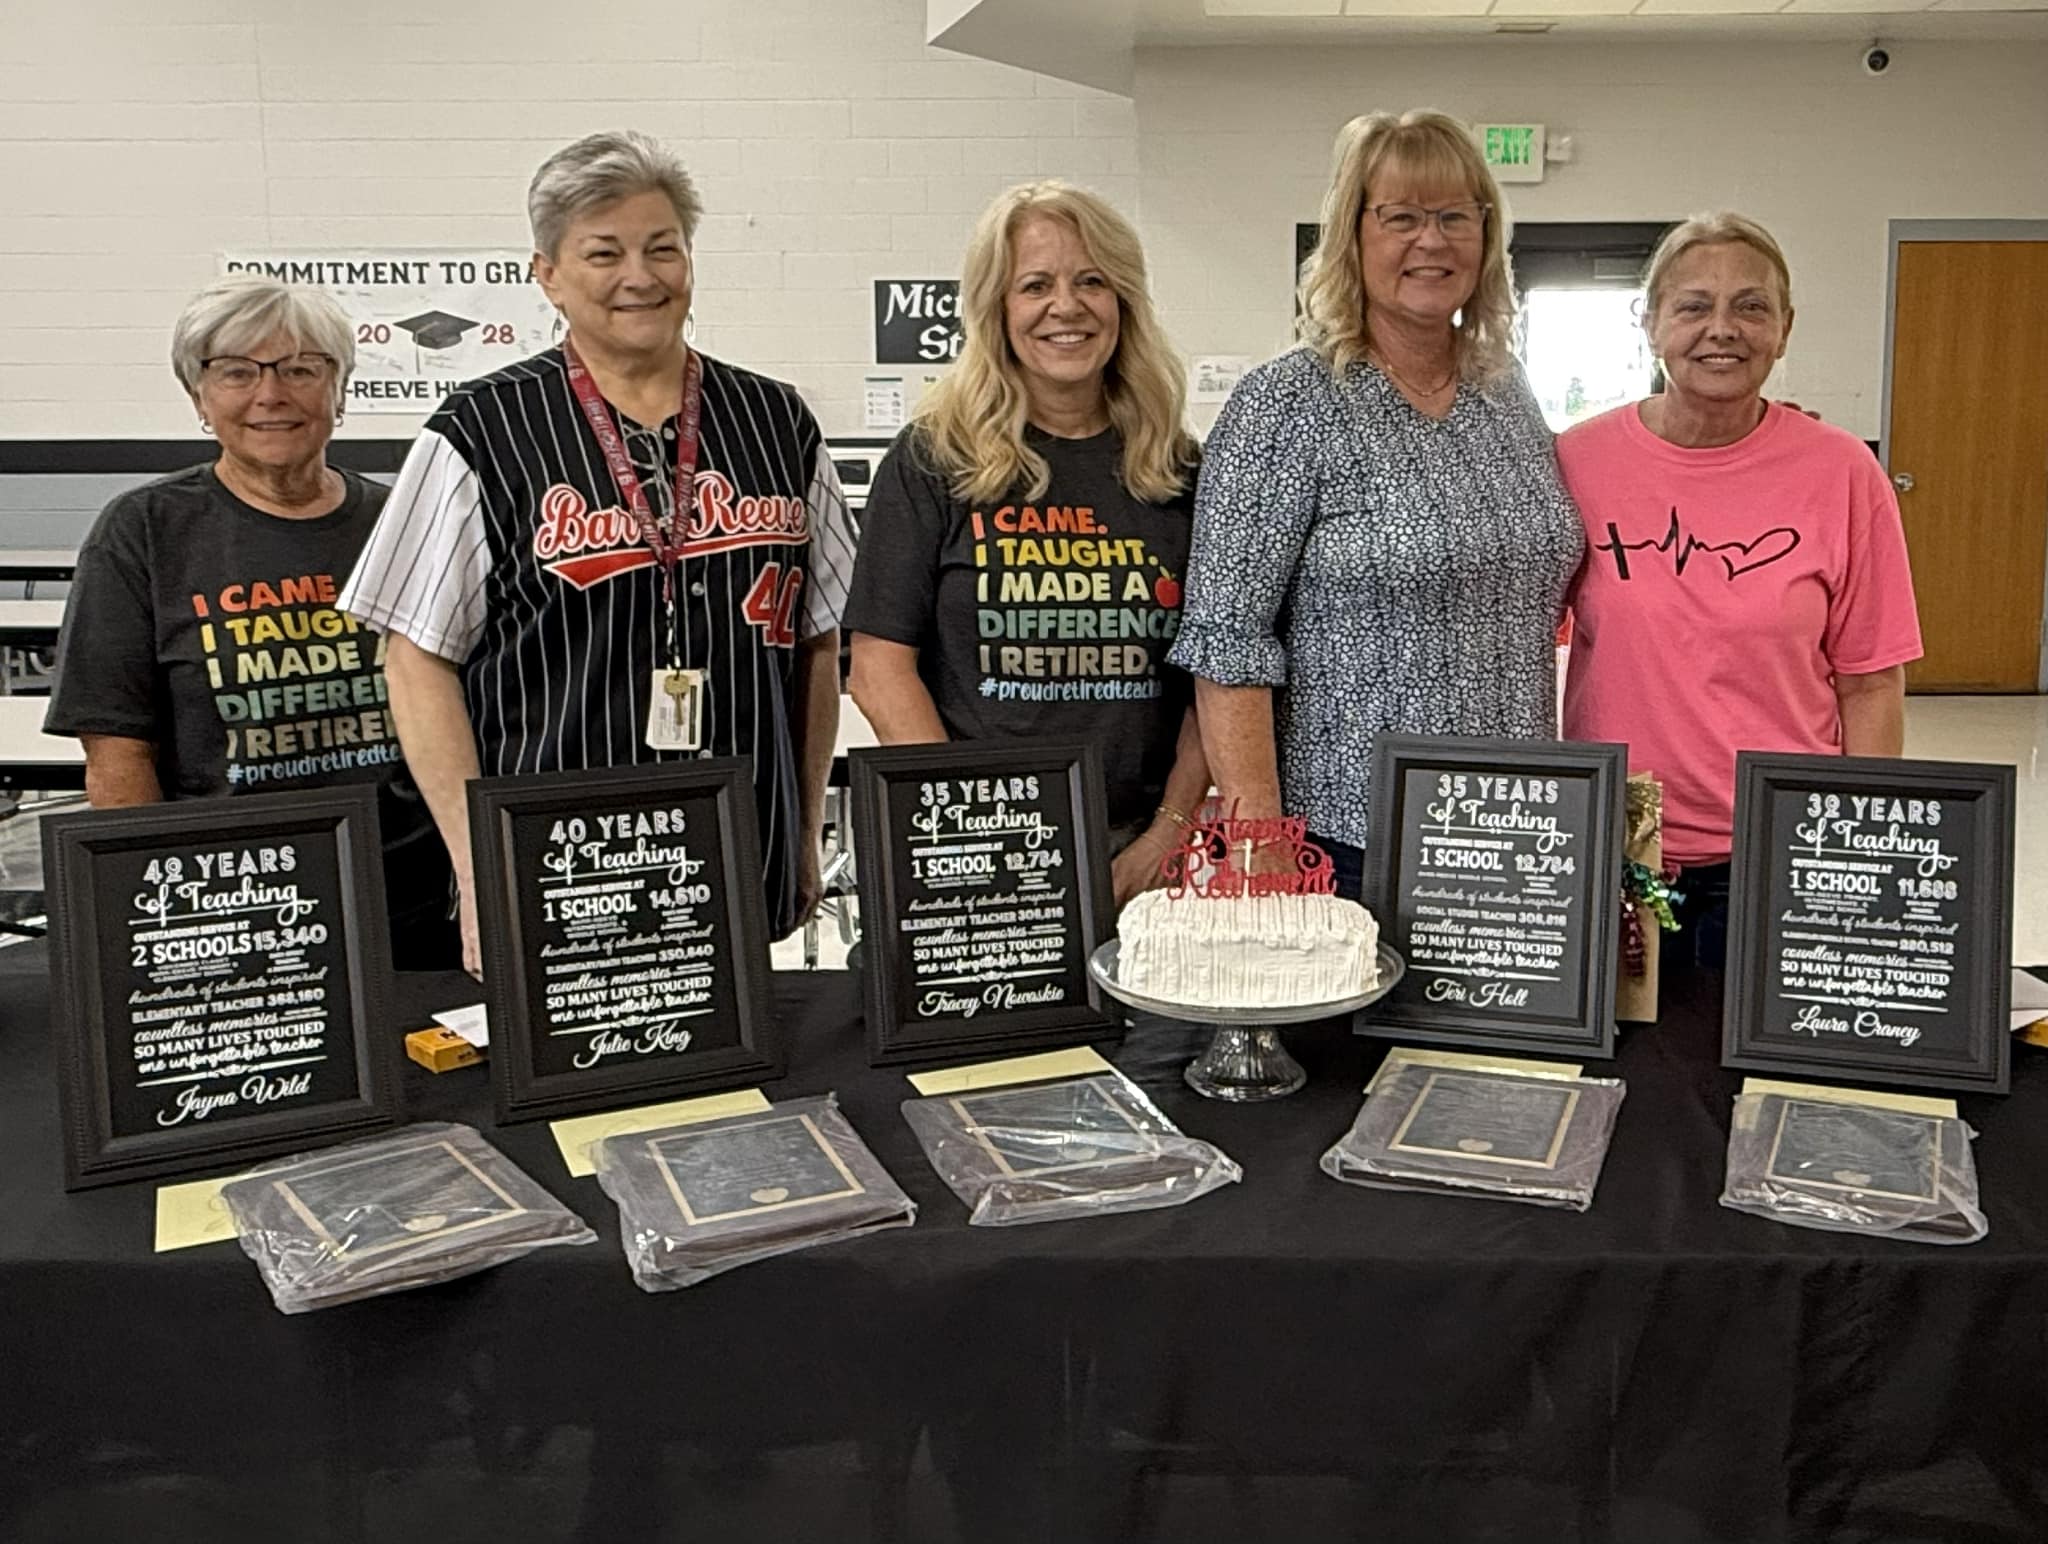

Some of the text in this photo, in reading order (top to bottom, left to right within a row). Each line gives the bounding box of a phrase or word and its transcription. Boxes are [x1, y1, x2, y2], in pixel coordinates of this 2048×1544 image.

[439, 262, 476, 284] TO
[357, 324, 515, 344] 20 28
[971, 506, 1109, 540] I CAME.
[975, 538, 1159, 567] I TAUGHT.
[977, 571, 1150, 603] I MADE A
[192, 594, 209, 617] I
[200, 623, 218, 654] I
[977, 608, 1179, 640] DIFFERENCE
[207, 657, 224, 689] I
[236, 640, 361, 685] MADE
[979, 644, 991, 674] I
[226, 730, 238, 760] I
[920, 776, 1040, 807] 35 YEARS
[1437, 774, 1560, 804] 35 YEARS
[912, 802, 1059, 850] of Teaching
[1426, 797, 1574, 854] of Teaching
[1807, 793, 1942, 827] 32 YEARS
[549, 808, 686, 845] 40 YEARS
[194, 845, 298, 880] YEARS
[542, 836, 706, 886] of Teaching
[1419, 846, 1431, 866] 1
[1434, 847, 1504, 871] SCHOOL
[1795, 817, 1959, 878] of Teaching
[911, 859, 924, 879] 1
[926, 854, 997, 878] SCHOOL
[1789, 869, 1801, 889] 1
[1804, 871, 1883, 896] SCHOOL
[133, 874, 319, 928] of Teaching
[542, 901, 557, 923] 1
[559, 892, 638, 921] SCHOOL
[130, 944, 148, 968] 2
[151, 932, 252, 965] SCHOOLS
[252, 923, 328, 952] 15,340
[912, 935, 1065, 962] SO MANY LIVES TOUCHED
[1410, 932, 1564, 957] SO MANY LIVES TOUCHED
[1779, 960, 1951, 987] SO MANY LIVES TOUCHED
[546, 975, 713, 1011] SO MANY LIVES TOUCHED
[917, 990, 982, 1019] Tracy
[1791, 1004, 1851, 1039] Laura
[133, 1020, 326, 1060] SO MANY LIVES TOUCHED
[572, 1019, 693, 1069] Julie King
[156, 1072, 313, 1127] Jayna Wild
